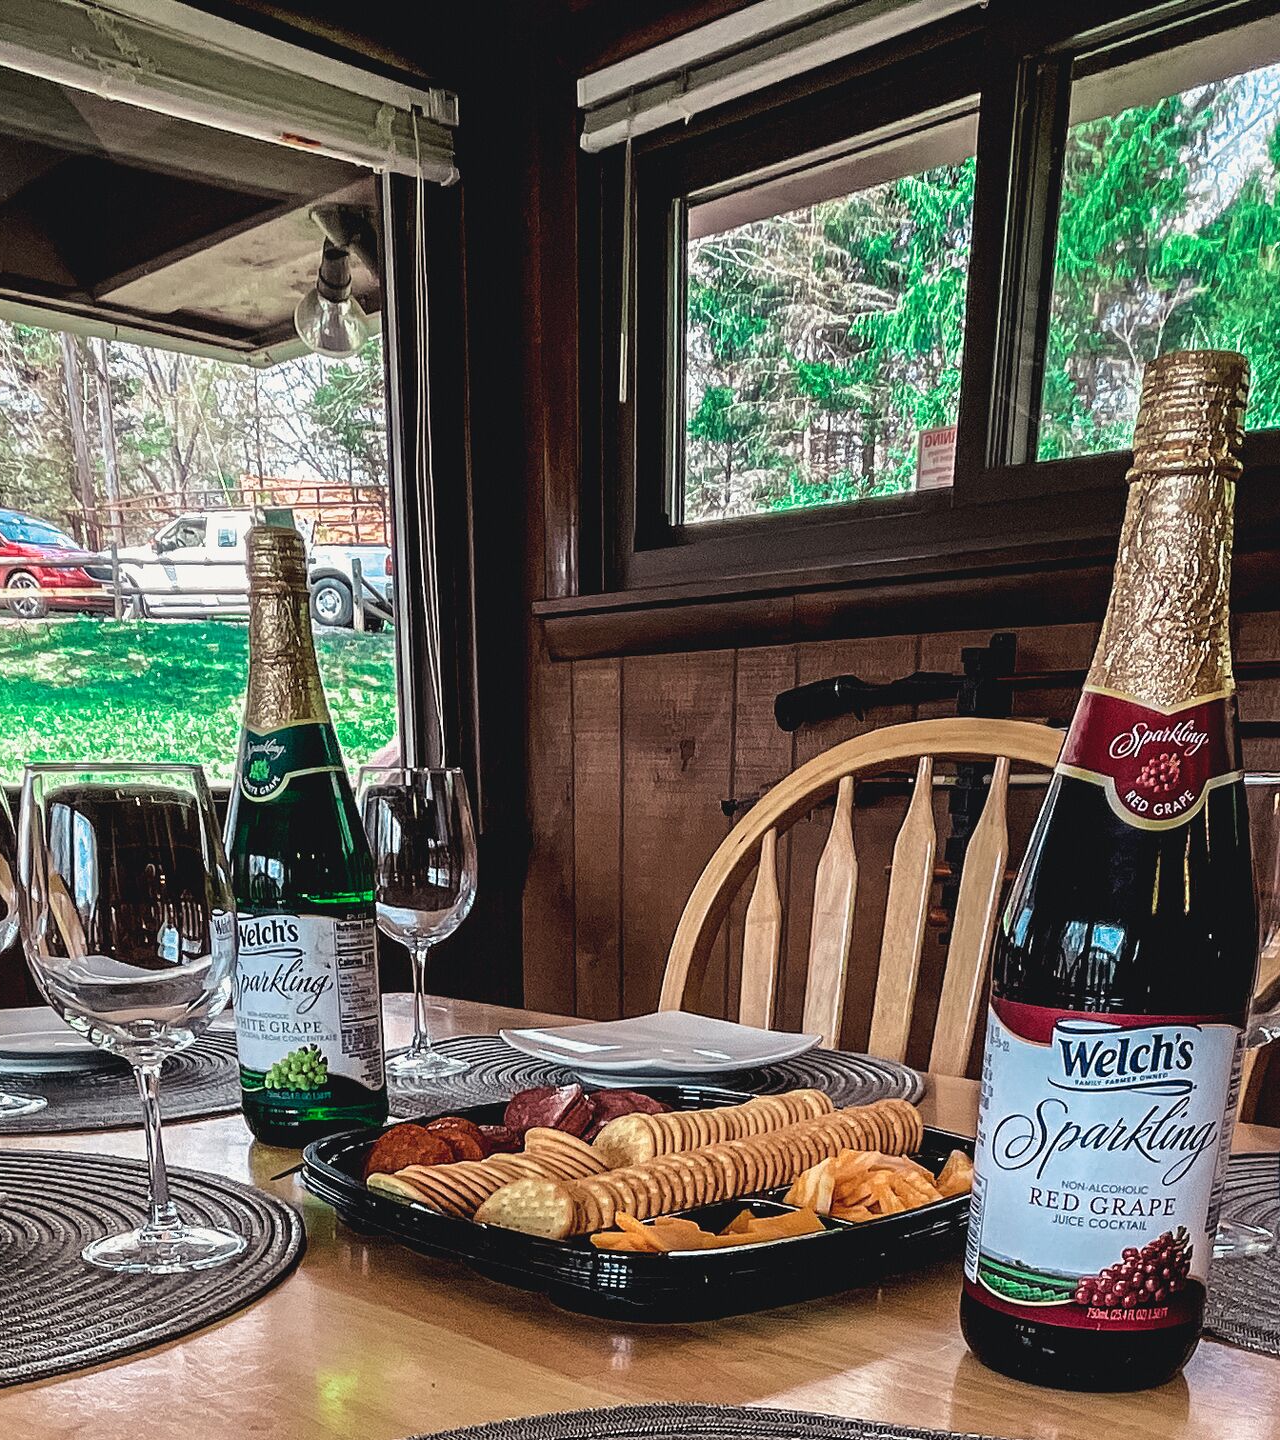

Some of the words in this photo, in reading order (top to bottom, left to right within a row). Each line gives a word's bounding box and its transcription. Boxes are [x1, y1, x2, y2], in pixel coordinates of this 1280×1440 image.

[1109, 719, 1210, 759] Sparkling
[260, 776, 280, 795] GRAPE
[1125, 790, 1148, 812] RED
[1153, 790, 1195, 816] GRAPE
[269, 1020, 323, 1034] GRAPE
[1057, 1033, 1195, 1078] Welch's
[1105, 1075, 1137, 1086] FARMER
[1139, 1072, 1169, 1081] OWNED
[992, 1096, 1217, 1186] Sparkling
[1061, 1180, 1150, 1195] NON-ALCOHOLIC
[1029, 1187, 1080, 1212] RED
[1089, 1196, 1177, 1217] GRAPE
[1052, 1213, 1085, 1227] JUICE
[1088, 1217, 1148, 1231] COCKTAIL
